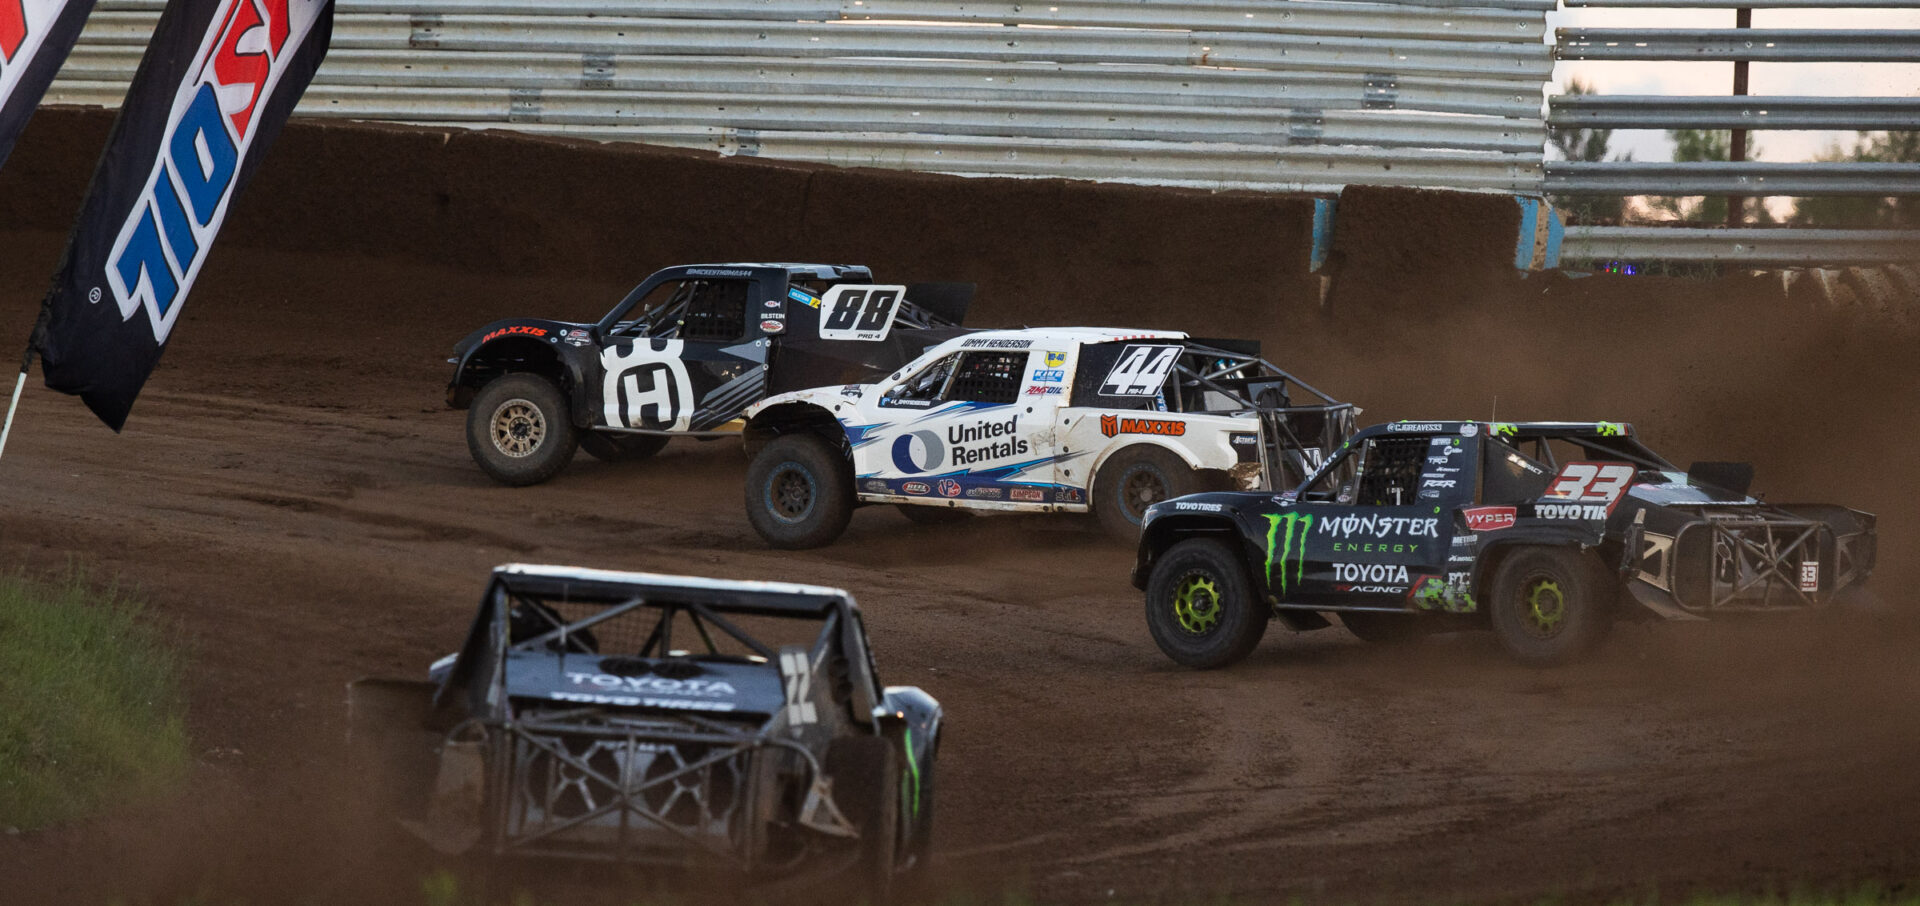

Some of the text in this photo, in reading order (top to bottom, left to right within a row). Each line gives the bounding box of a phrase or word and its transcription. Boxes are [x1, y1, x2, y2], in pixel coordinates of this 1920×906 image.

[114, 0, 290, 322] SOIL
[823, 289, 899, 331] 88
[481, 326, 548, 343] MAXXIS
[961, 338, 1034, 349] JIMMY HENDERSON
[1047, 352, 1065, 362] WD-40
[1034, 370, 1064, 378] KING
[1105, 346, 1180, 395] 44
[1025, 385, 1063, 395] AMSOIL
[948, 414, 1018, 444] United
[1120, 418, 1186, 436] MAXXIS
[1387, 422, 1443, 432] @CJGREAVES33
[952, 436, 1028, 466] Rentals
[1427, 456, 1449, 464] TRD
[1423, 479, 1457, 488] RZR
[1544, 464, 1635, 502] 33
[1175, 502, 1223, 512] TOYO TIRES
[1534, 504, 1582, 520] TOYO
[1466, 513, 1514, 524] VYPER
[1333, 543, 1419, 553] ENERGY
[1332, 563, 1409, 583] TOYOTA
[1802, 566, 1817, 583] 33
[566, 672, 737, 695] TOYOTA
[780, 652, 818, 726] 22
